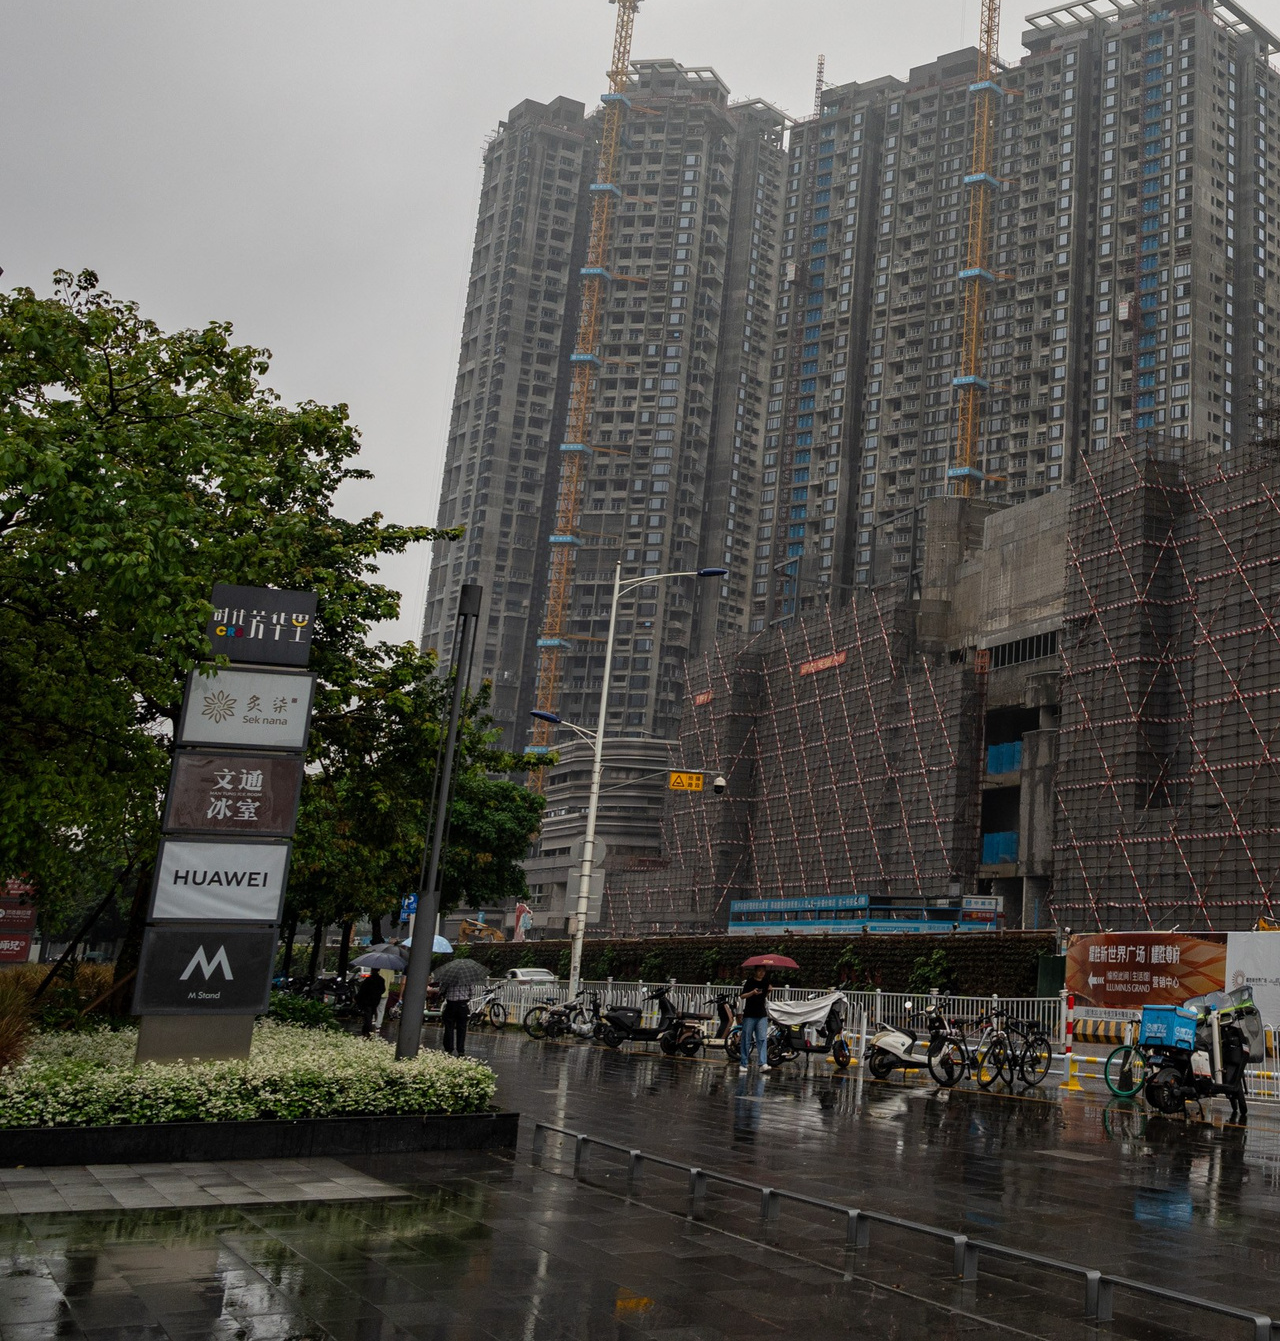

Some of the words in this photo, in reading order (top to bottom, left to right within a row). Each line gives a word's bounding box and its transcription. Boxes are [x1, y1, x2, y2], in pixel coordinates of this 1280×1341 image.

[242, 715, 260, 724] Sek
[262, 717, 288, 726] nana
[212, 768, 264, 791] 文通
[207, 797, 261, 821] 冰室
[173, 869, 268, 887] HUAWEI
[179, 944, 235, 981] M
[1088, 945, 1146, 964] 耀胜新世界广场
[1151, 945, 1181, 965] 耀胜尊府
[1132, 984, 1151, 993] GRAND
[1152, 975, 1180, 989] 营销中心
[197, 991, 221, 999] Stand
